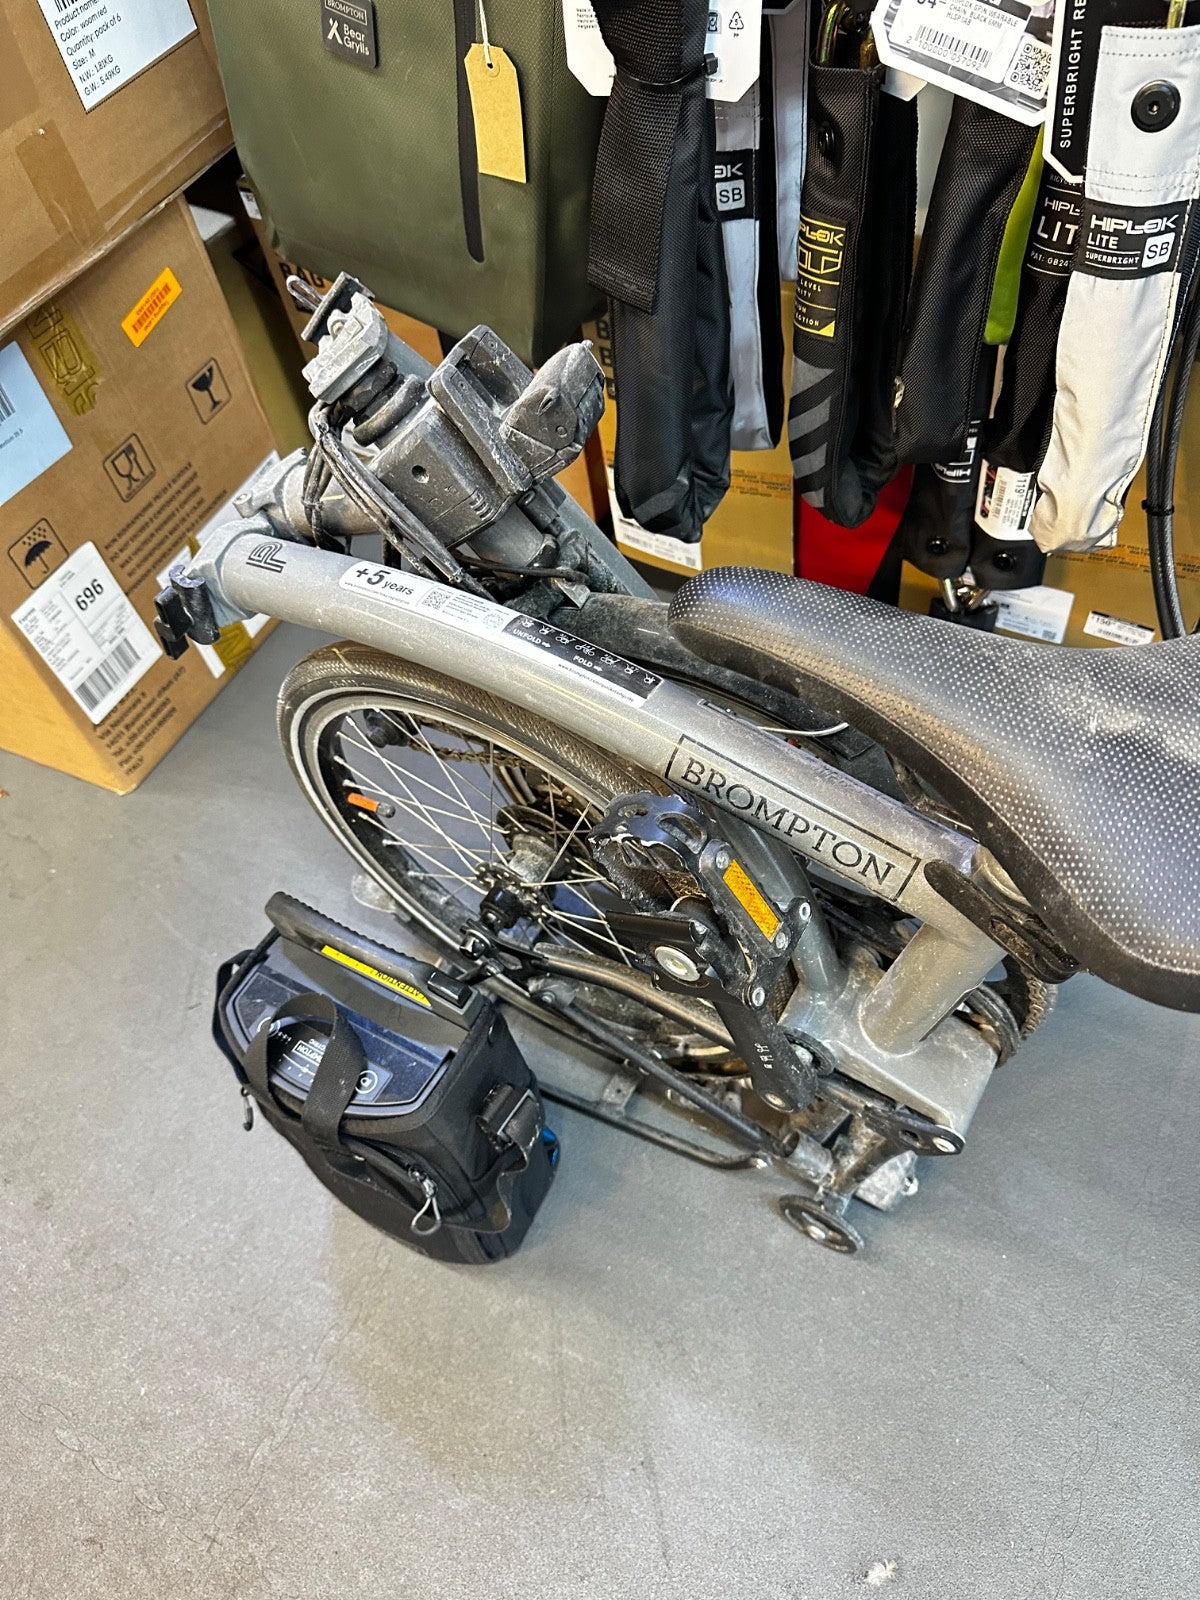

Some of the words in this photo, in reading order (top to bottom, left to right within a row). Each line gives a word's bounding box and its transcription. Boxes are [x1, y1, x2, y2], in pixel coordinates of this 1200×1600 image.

[54, 11, 81, 30] Product
[327, 0, 365, 21] BROMPTON
[950, 4, 967, 16] CHAIN
[969, 12, 987, 24] BLACK
[988, 8, 1018, 27] WEARABLE
[60, 28, 80, 42] Color:
[80, 13, 99, 30] woom
[97, 6, 107, 20] red
[343, 23, 366, 42] Bear
[67, 33, 94, 56] Quantity:
[94, 22, 111, 38] pack
[343, 35, 370, 57] Grylls
[72, 57, 88, 70] Size:
[89, 49, 96, 59] M
[951, 54, 982, 70] 057092
[1060, 29, 1083, 148] SUPERBRIGHT
[719, 187, 743, 204] SB
[1044, 197, 1080, 216] HIPL
[1037, 215, 1078, 245] LIT
[1089, 214, 1179, 235] HIPLOK
[800, 223, 844, 247] PLOK
[1087, 233, 1118, 249] LITE
[1085, 251, 1140, 265] SUPERBRIGHT
[1147, 240, 1170, 260] SB
[1047, 256, 1072, 269] GB24
[800, 279, 822, 292] LEVEL
[356, 568, 391, 586] +5
[383, 579, 414, 596] years
[76, 578, 104, 611] 696
[513, 628, 542, 644] UNFOLD
[573, 655, 593, 668] FOLD
[681, 757, 896, 885] BROMPTON
[375, 969, 420, 997] ATTENTION
[295, 1042, 323, 1063] MPTON
